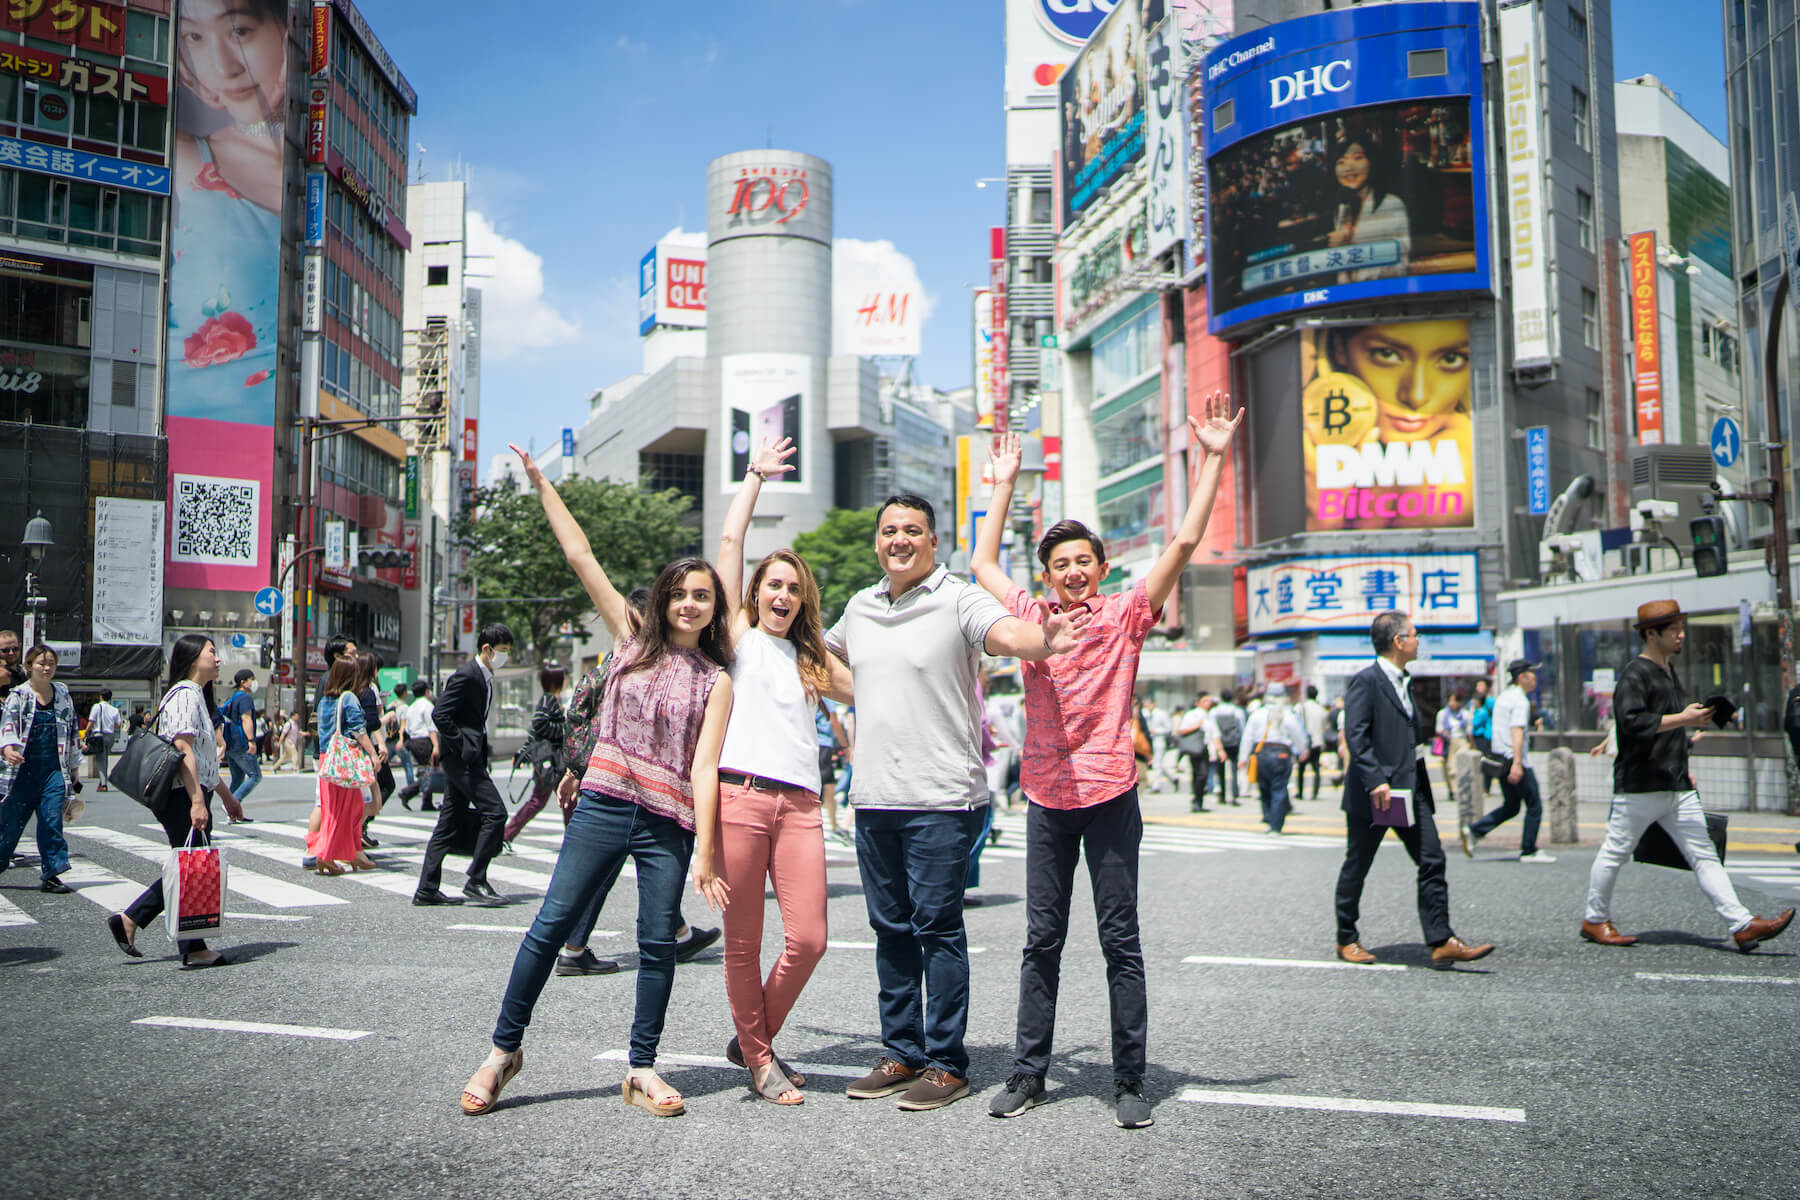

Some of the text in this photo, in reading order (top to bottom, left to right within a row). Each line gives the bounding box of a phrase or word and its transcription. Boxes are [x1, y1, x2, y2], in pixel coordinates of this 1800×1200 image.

[60, 58, 148, 101] ガスト
[1208, 37, 1275, 80] DHC Channel
[1269, 59, 1352, 108] DHC
[312, 120, 322, 155] ガスト
[1506, 42, 1534, 270] Taisei neon
[725, 176, 809, 225] 109
[1303, 289, 1329, 304] DHC
[1316, 439, 1465, 489] DMM
[1317, 486, 1464, 521] Bitcoin
[1255, 569, 1461, 617] 大盛堂書店
[374, 612, 400, 641] LUSH
